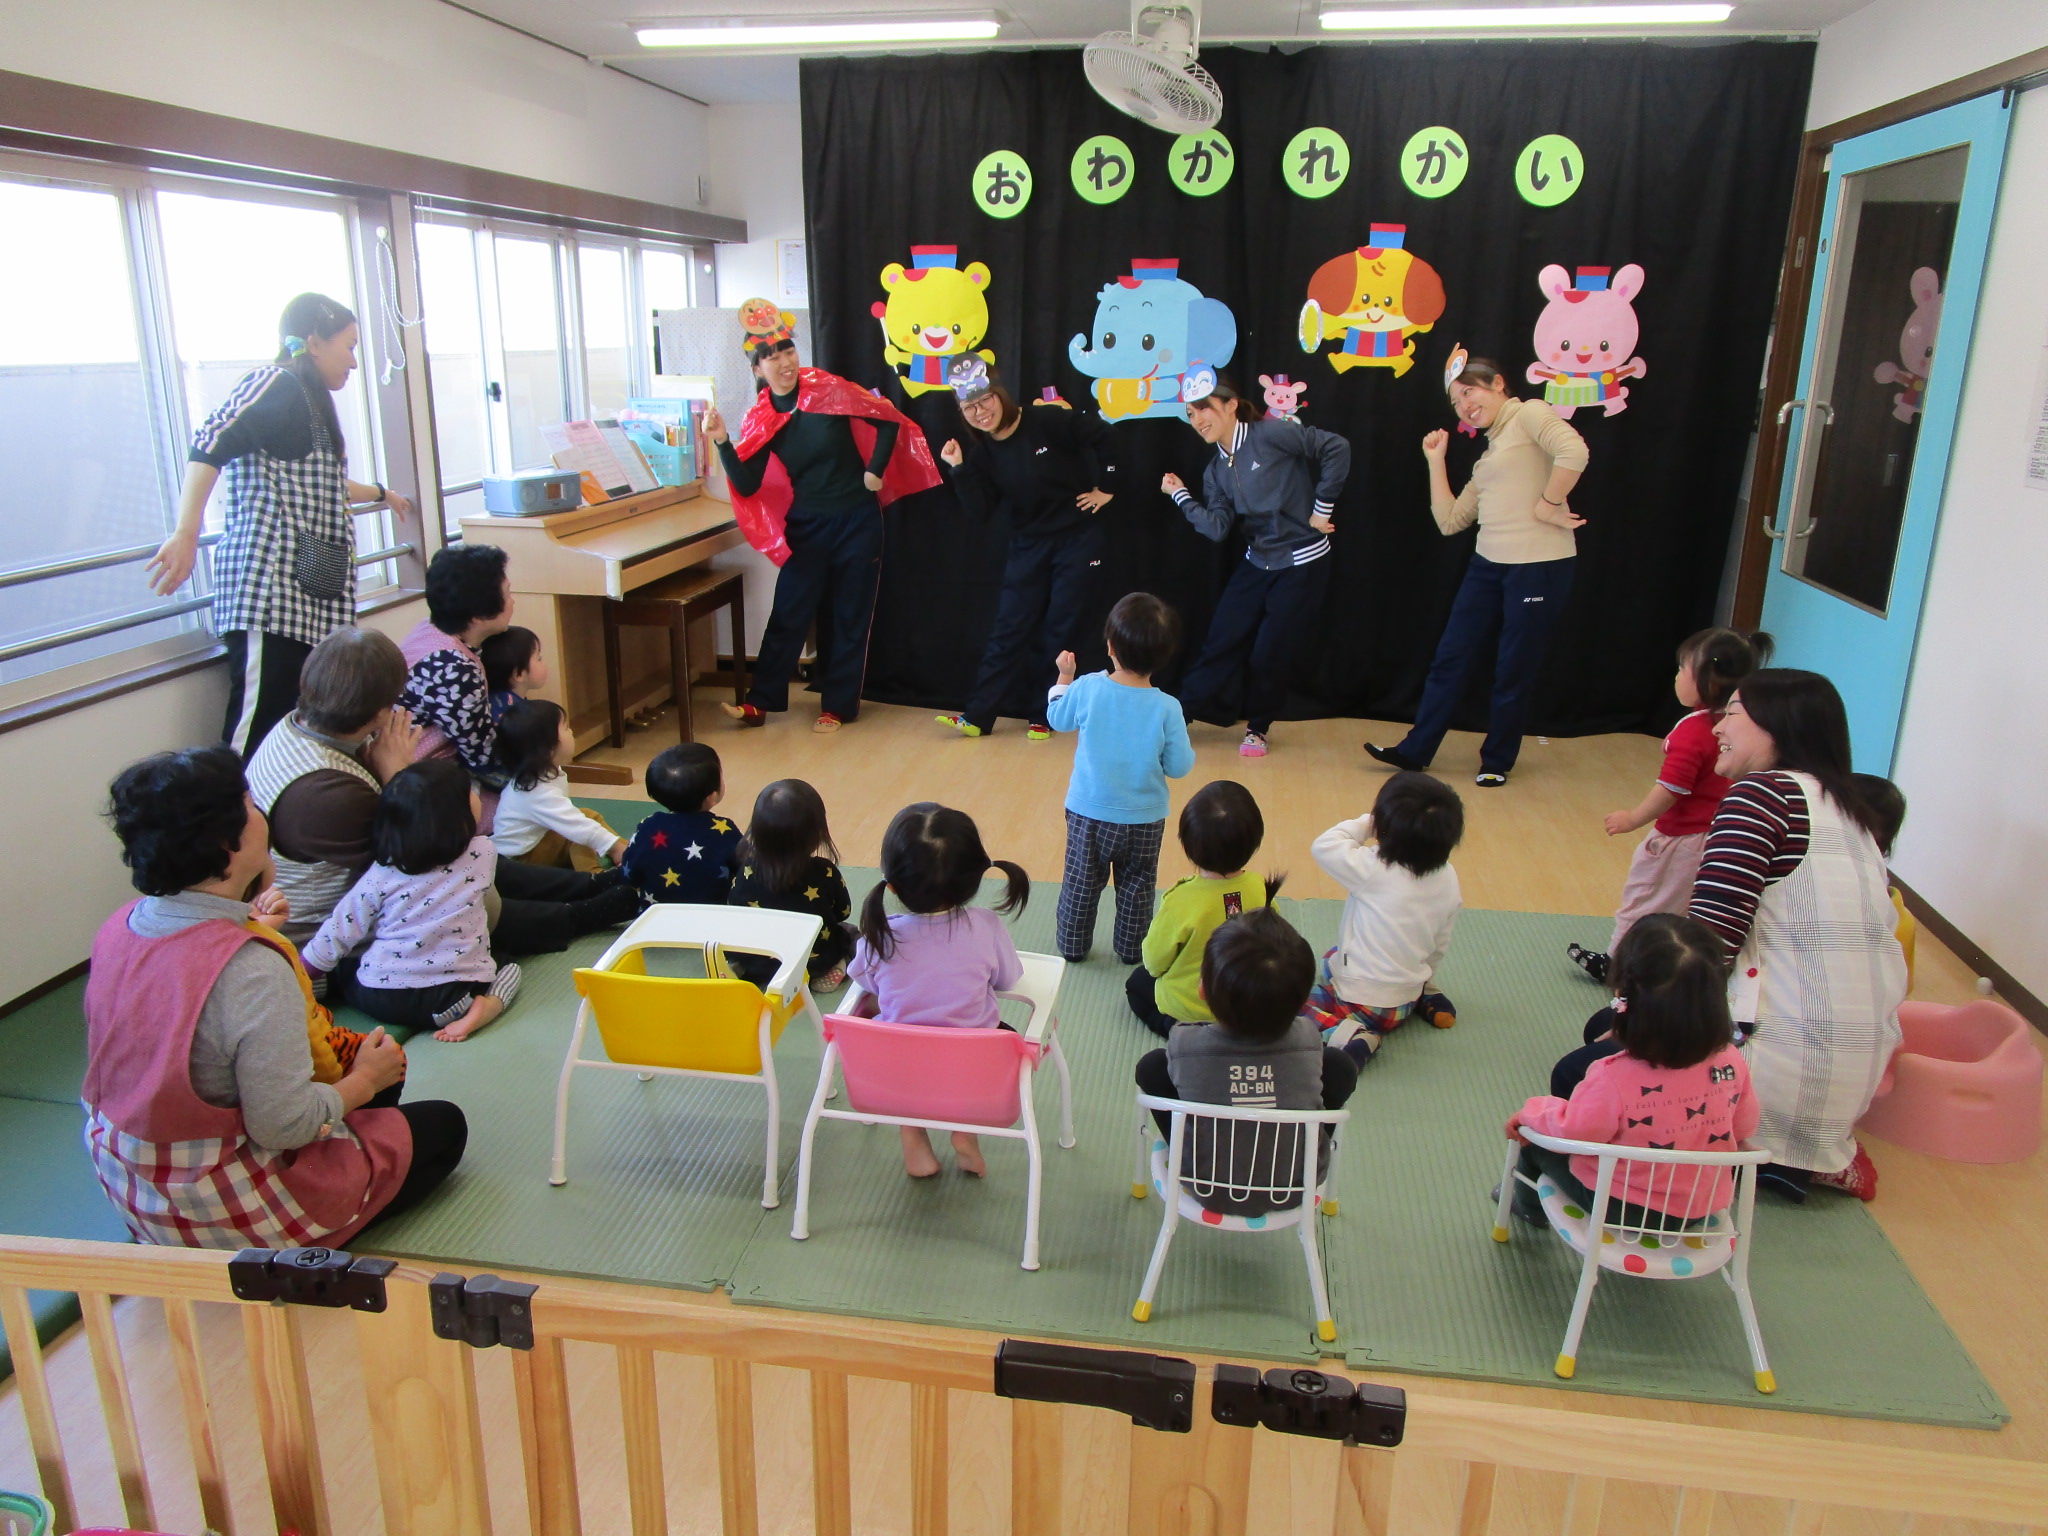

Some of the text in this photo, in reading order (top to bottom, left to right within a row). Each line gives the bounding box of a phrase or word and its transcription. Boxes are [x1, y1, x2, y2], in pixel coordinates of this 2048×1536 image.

[985, 138, 1573, 205] おわかれかい
[1229, 1064, 1274, 1081] 394
[1229, 1081, 1275, 1095] AD-BN
[1678, 1095, 1699, 1104] love
